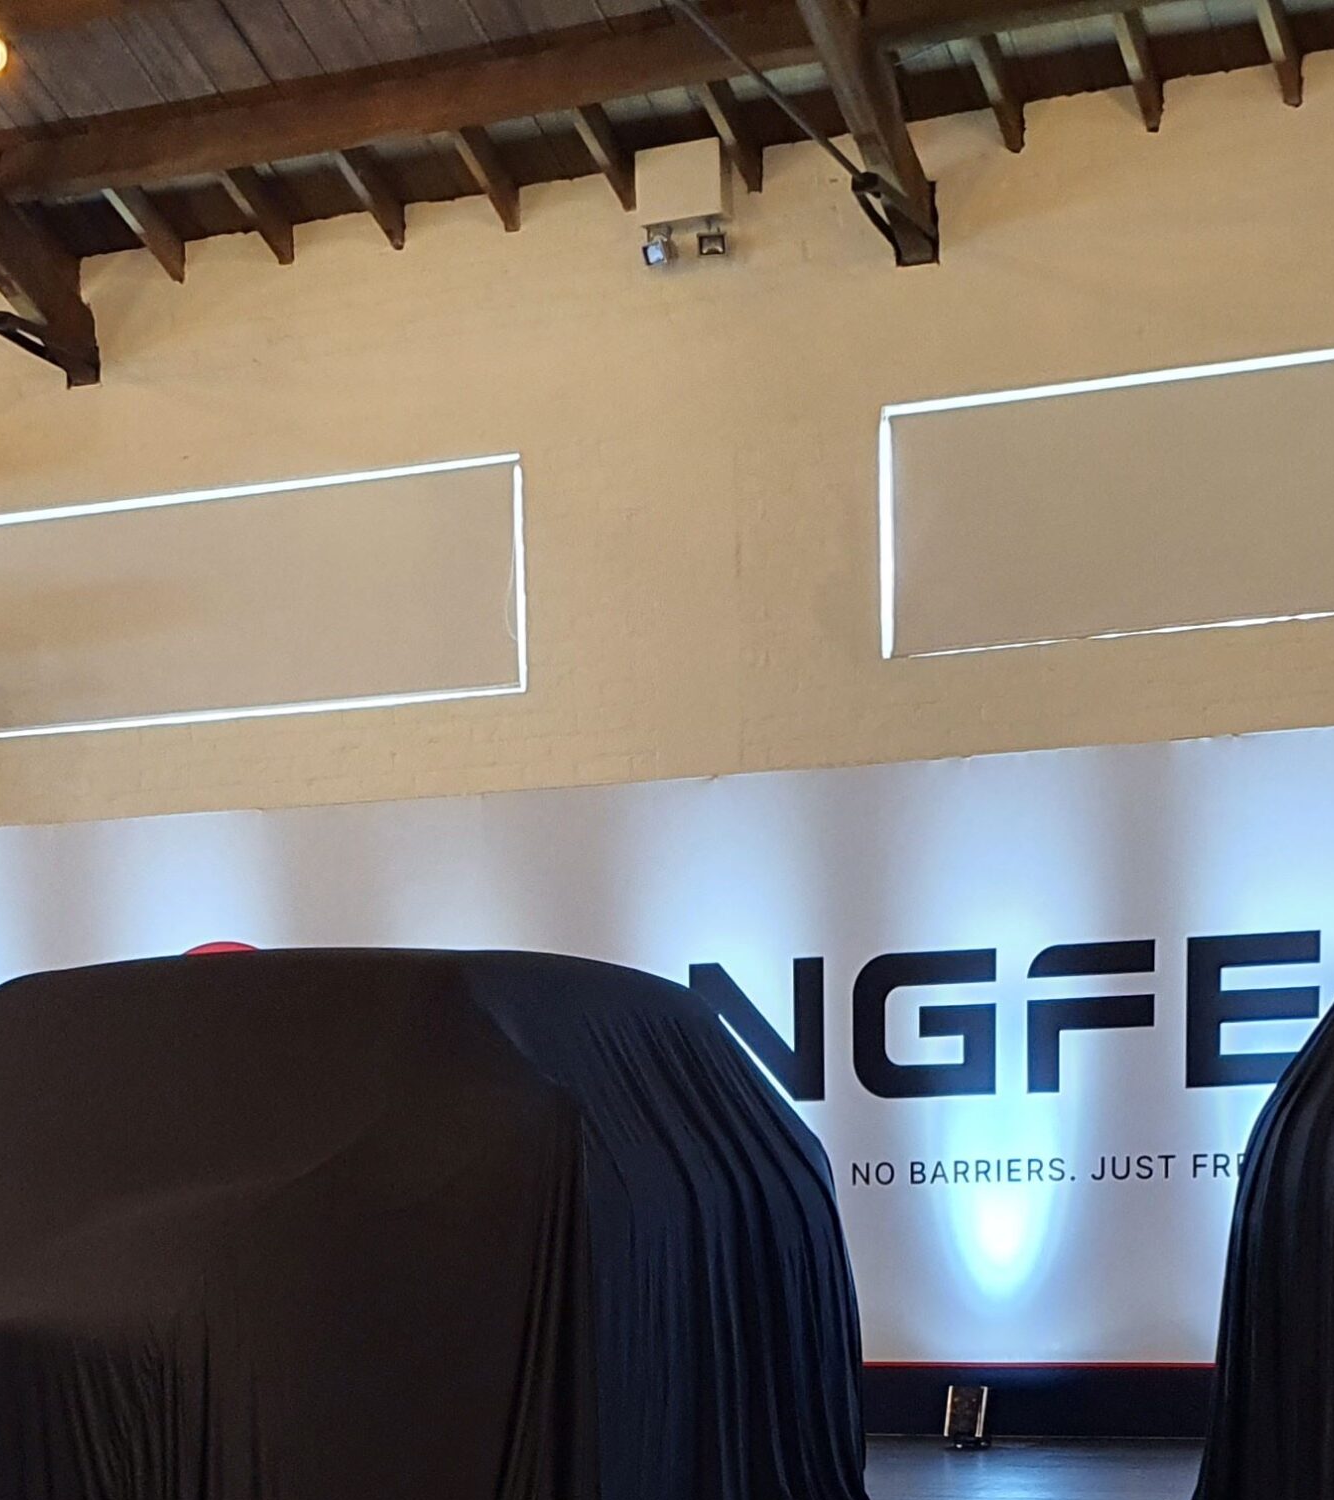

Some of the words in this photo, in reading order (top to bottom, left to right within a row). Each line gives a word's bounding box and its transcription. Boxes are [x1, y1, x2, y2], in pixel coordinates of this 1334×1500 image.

[851, 1162, 895, 1186] NO
[910, 1157, 1076, 1185] BARRIERS.
[1091, 1155, 1176, 1181] JUST
